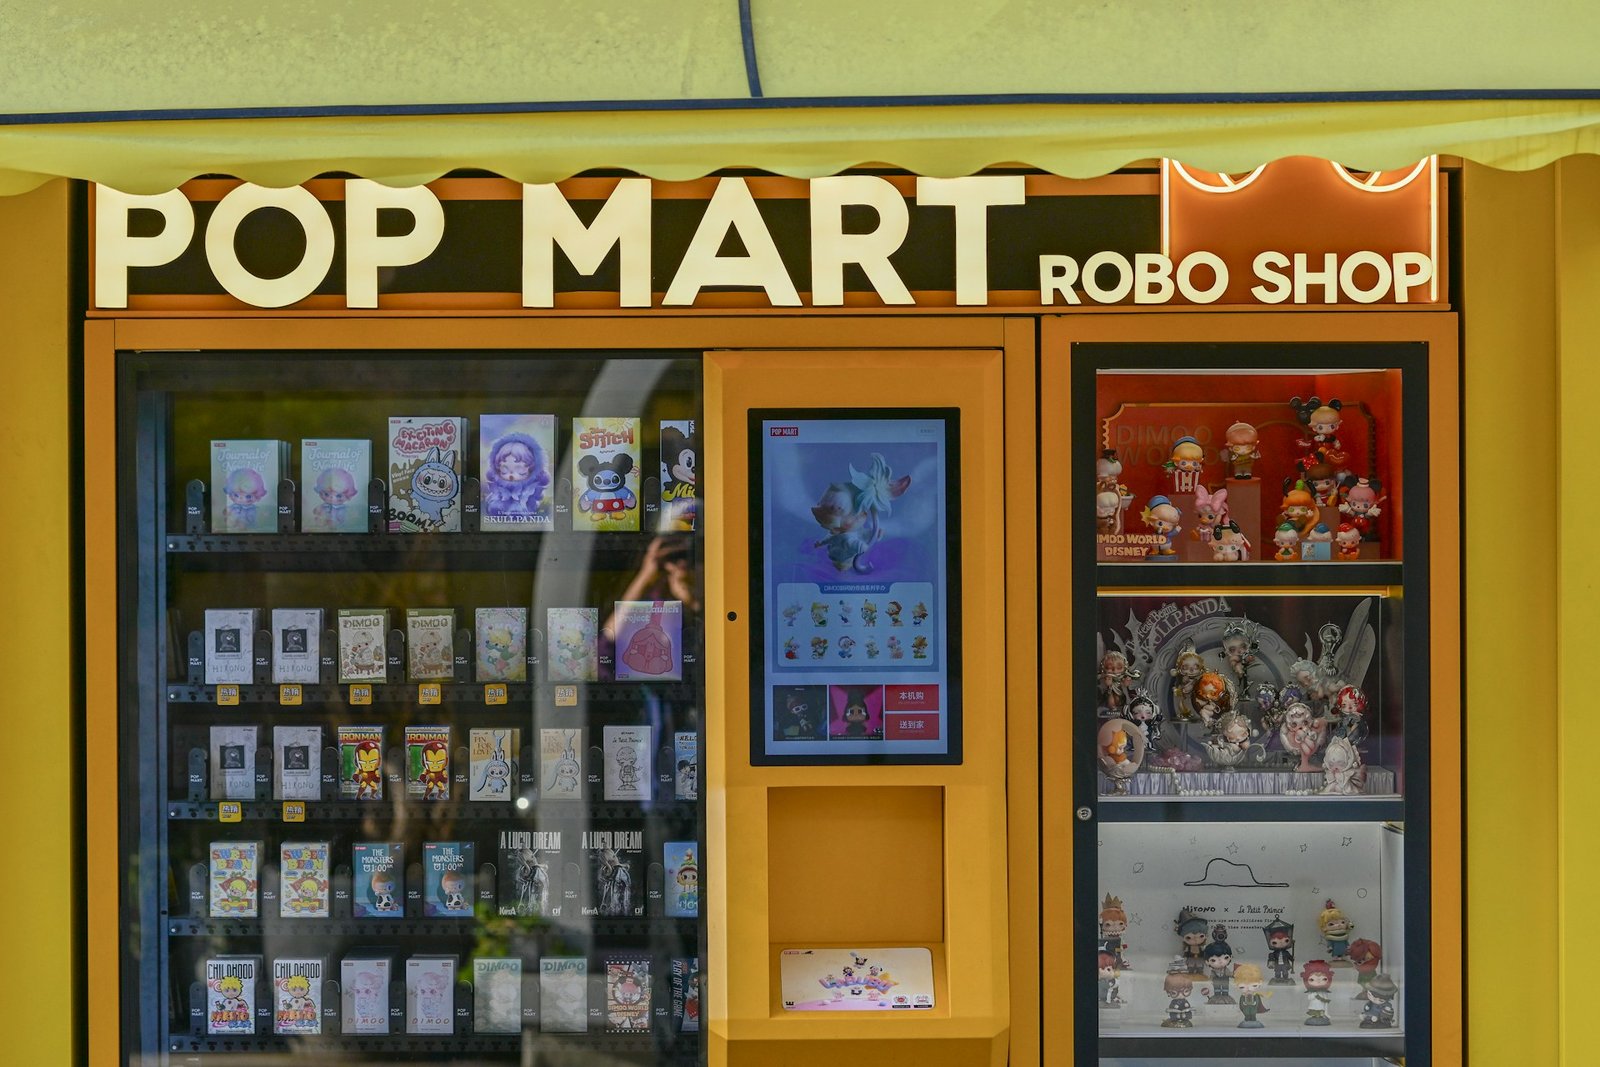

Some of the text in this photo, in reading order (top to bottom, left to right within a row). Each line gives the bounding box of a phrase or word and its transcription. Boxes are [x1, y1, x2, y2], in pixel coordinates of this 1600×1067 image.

[95, 175, 1025, 308] POP MART
[1039, 250, 1433, 305] ROBO SHOP
[483, 515, 551, 524] SKULLPANDA
[1126, 534, 1167, 544] WORLD
[1104, 546, 1148, 556] DISNEY
[899, 692, 924, 700] 本机购
[899, 720, 924, 729] 送到家
[500, 831, 507, 849] A
[533, 831, 561, 849] DREAM
[582, 831, 588, 849] A
[614, 831, 642, 849] DREAM
[1247, 905, 1261, 913] Petit
